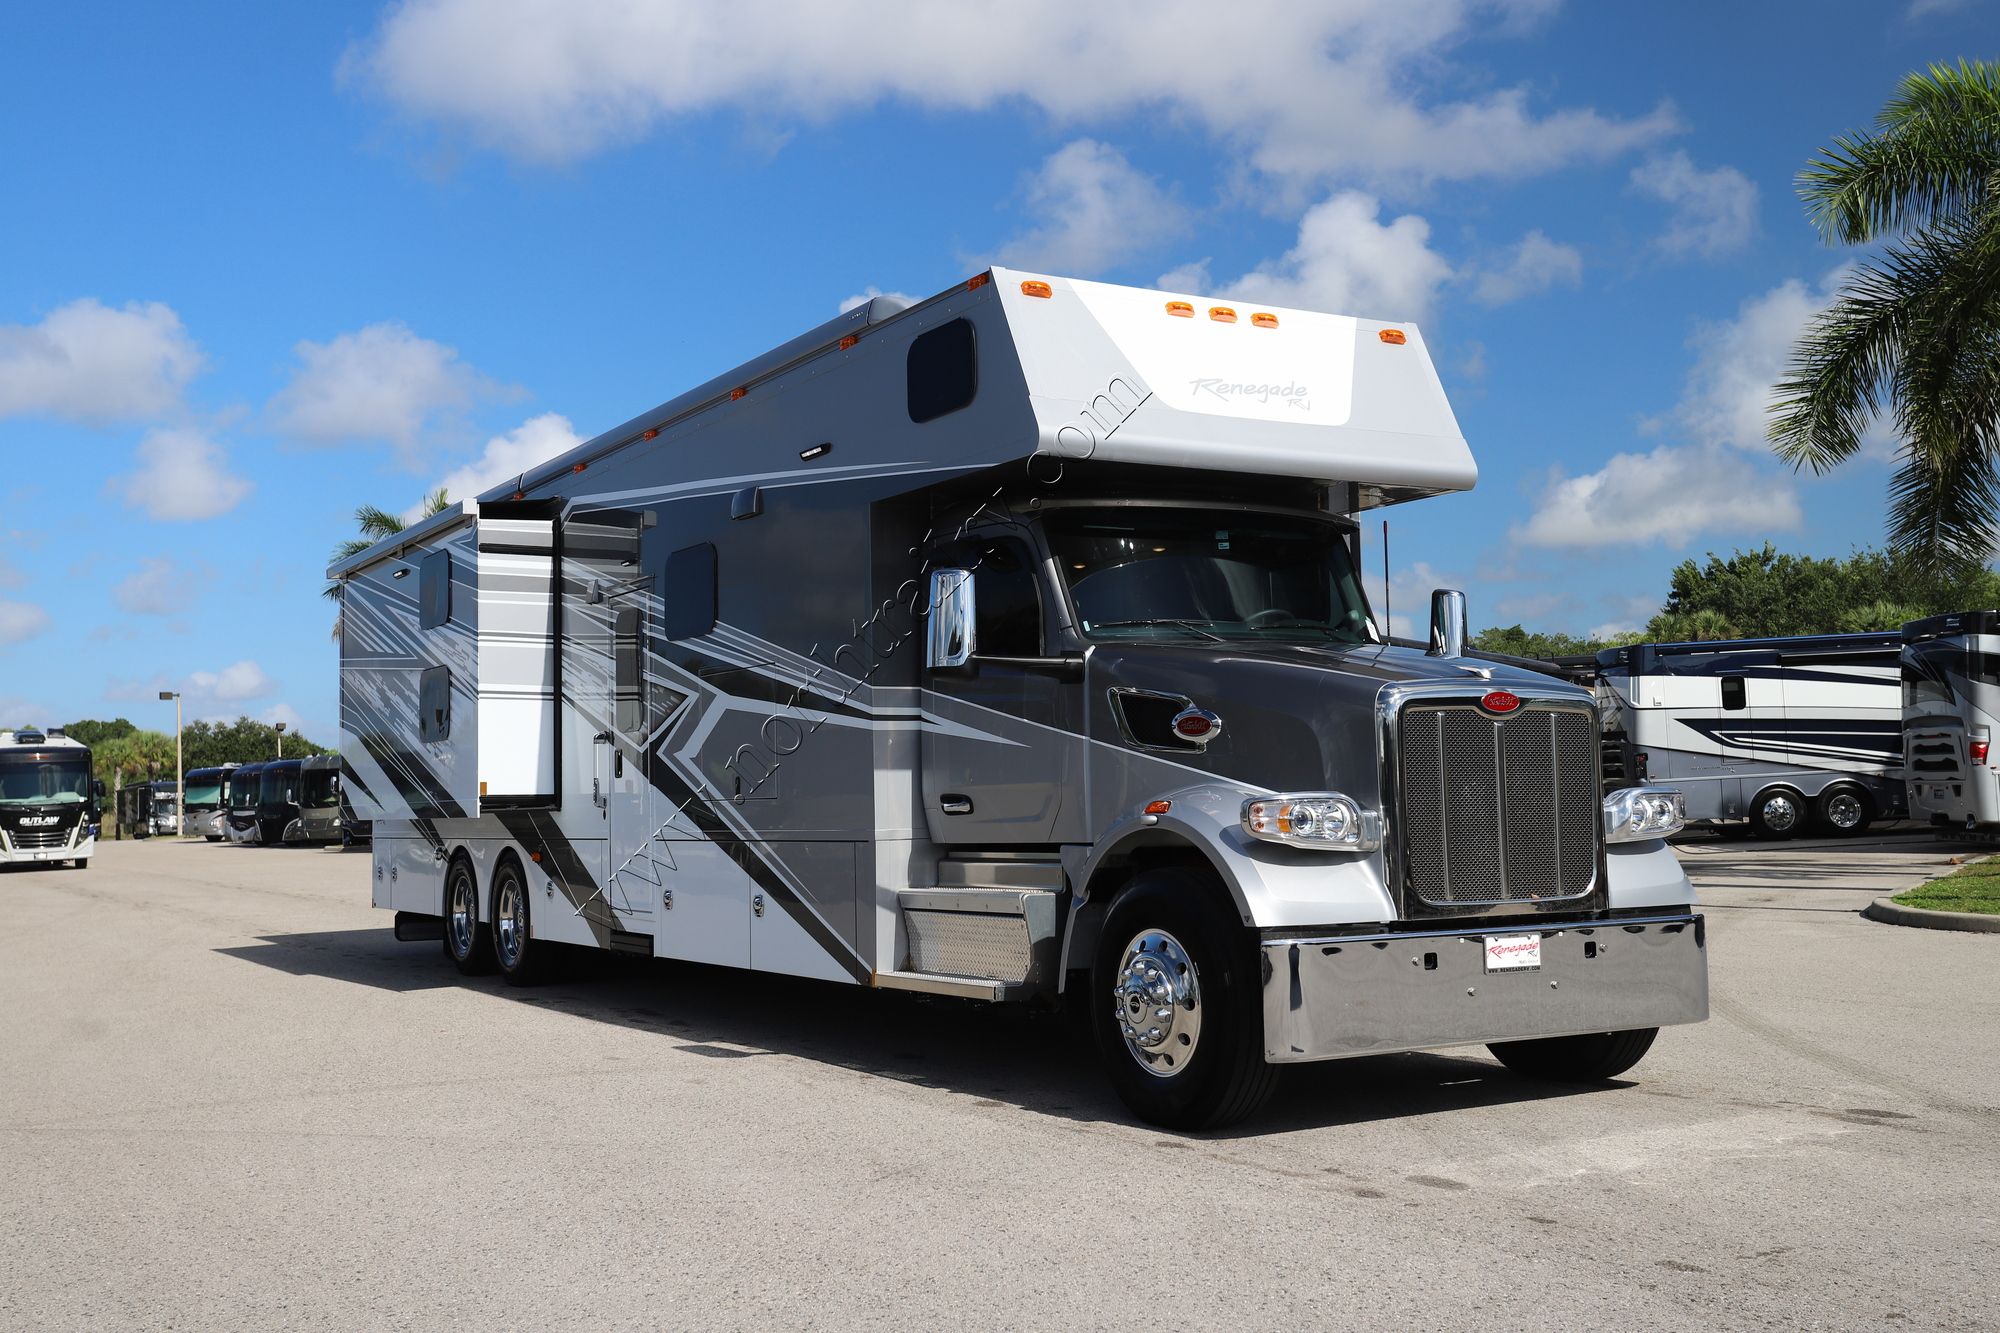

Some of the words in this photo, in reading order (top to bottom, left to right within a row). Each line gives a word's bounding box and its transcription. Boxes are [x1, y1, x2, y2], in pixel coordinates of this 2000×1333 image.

[1189, 378, 1308, 403] Renegade
[1286, 398, 1311, 411] RV
[19, 816, 60, 825] OUTLAW
[1487, 941, 1539, 959] Renegade
